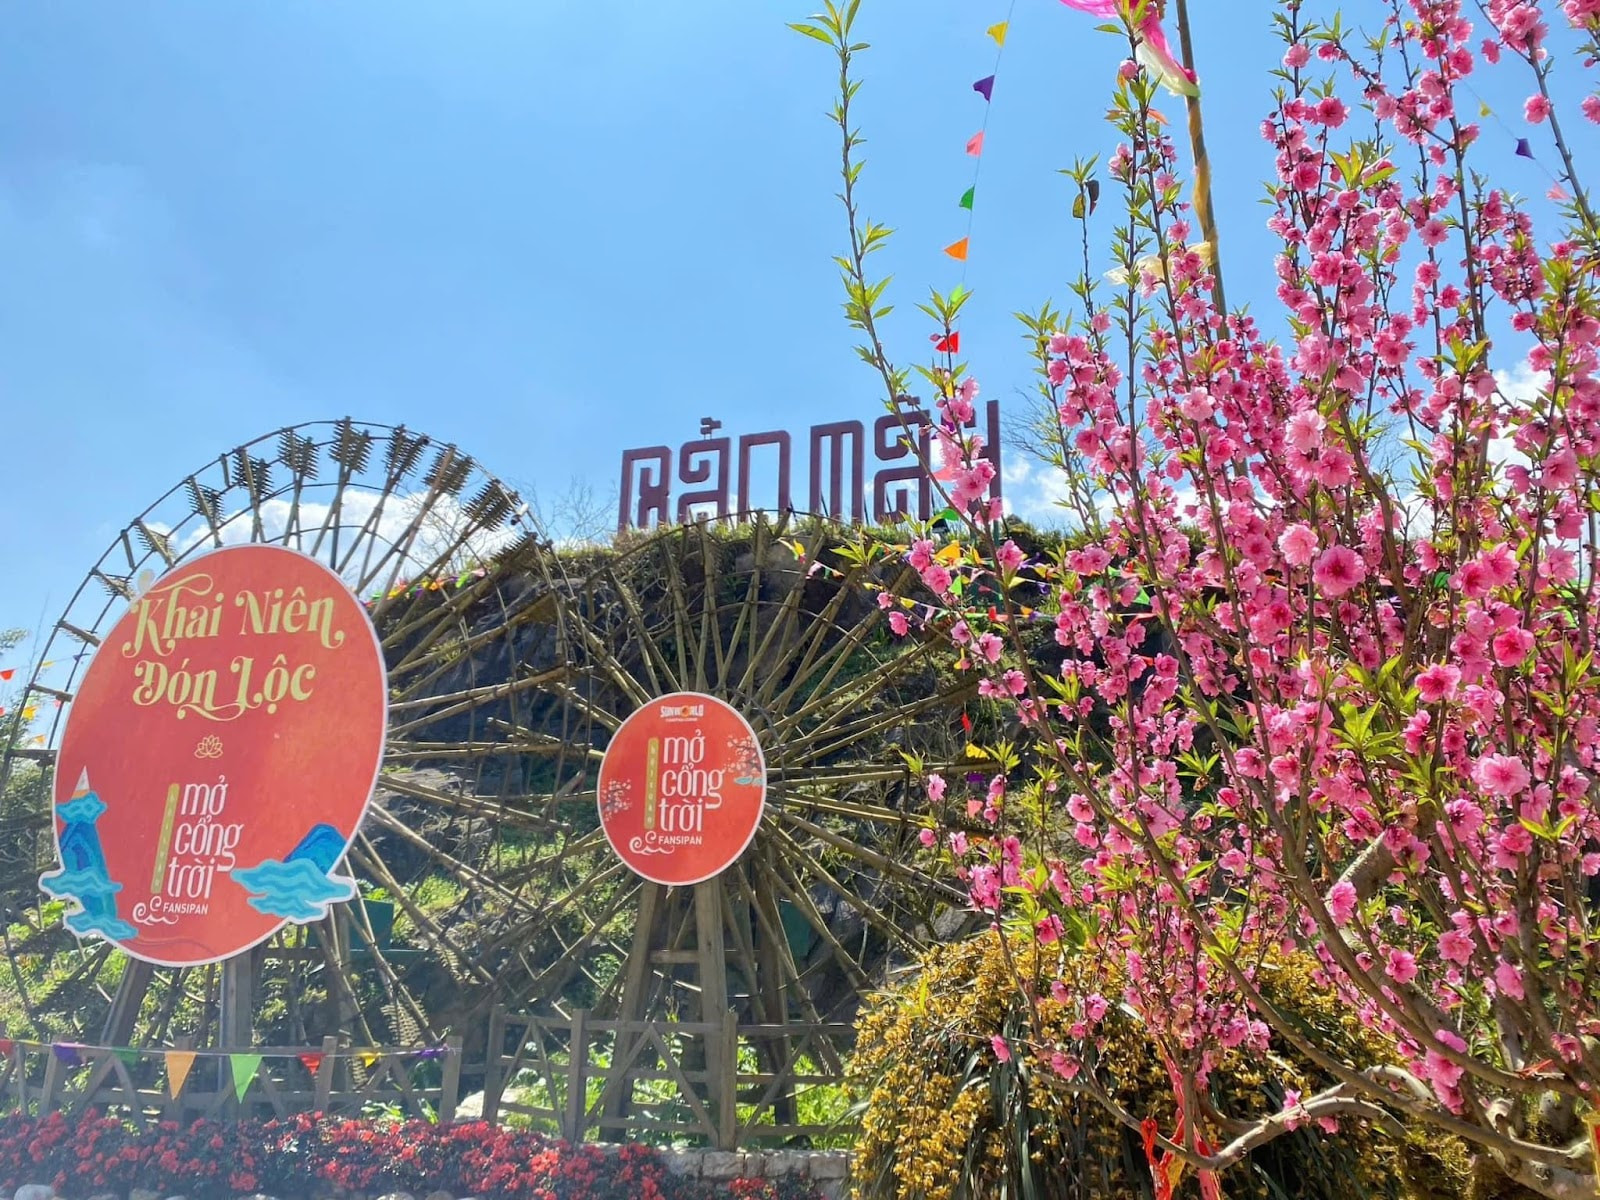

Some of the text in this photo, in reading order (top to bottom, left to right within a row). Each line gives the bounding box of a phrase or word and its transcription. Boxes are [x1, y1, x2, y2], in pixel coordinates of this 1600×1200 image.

[122, 573, 346, 658] Khai Niên
[132, 653, 316, 721] Đón Lộc
[664, 729, 706, 764] mở
[181, 774, 229, 815] mở
[662, 763, 727, 809] cổng
[658, 798, 703, 832] trời
[174, 814, 244, 872] cổng
[658, 835, 702, 845] FANSIPAN
[167, 857, 216, 899] trời
[163, 902, 208, 915] FANSIPAN
